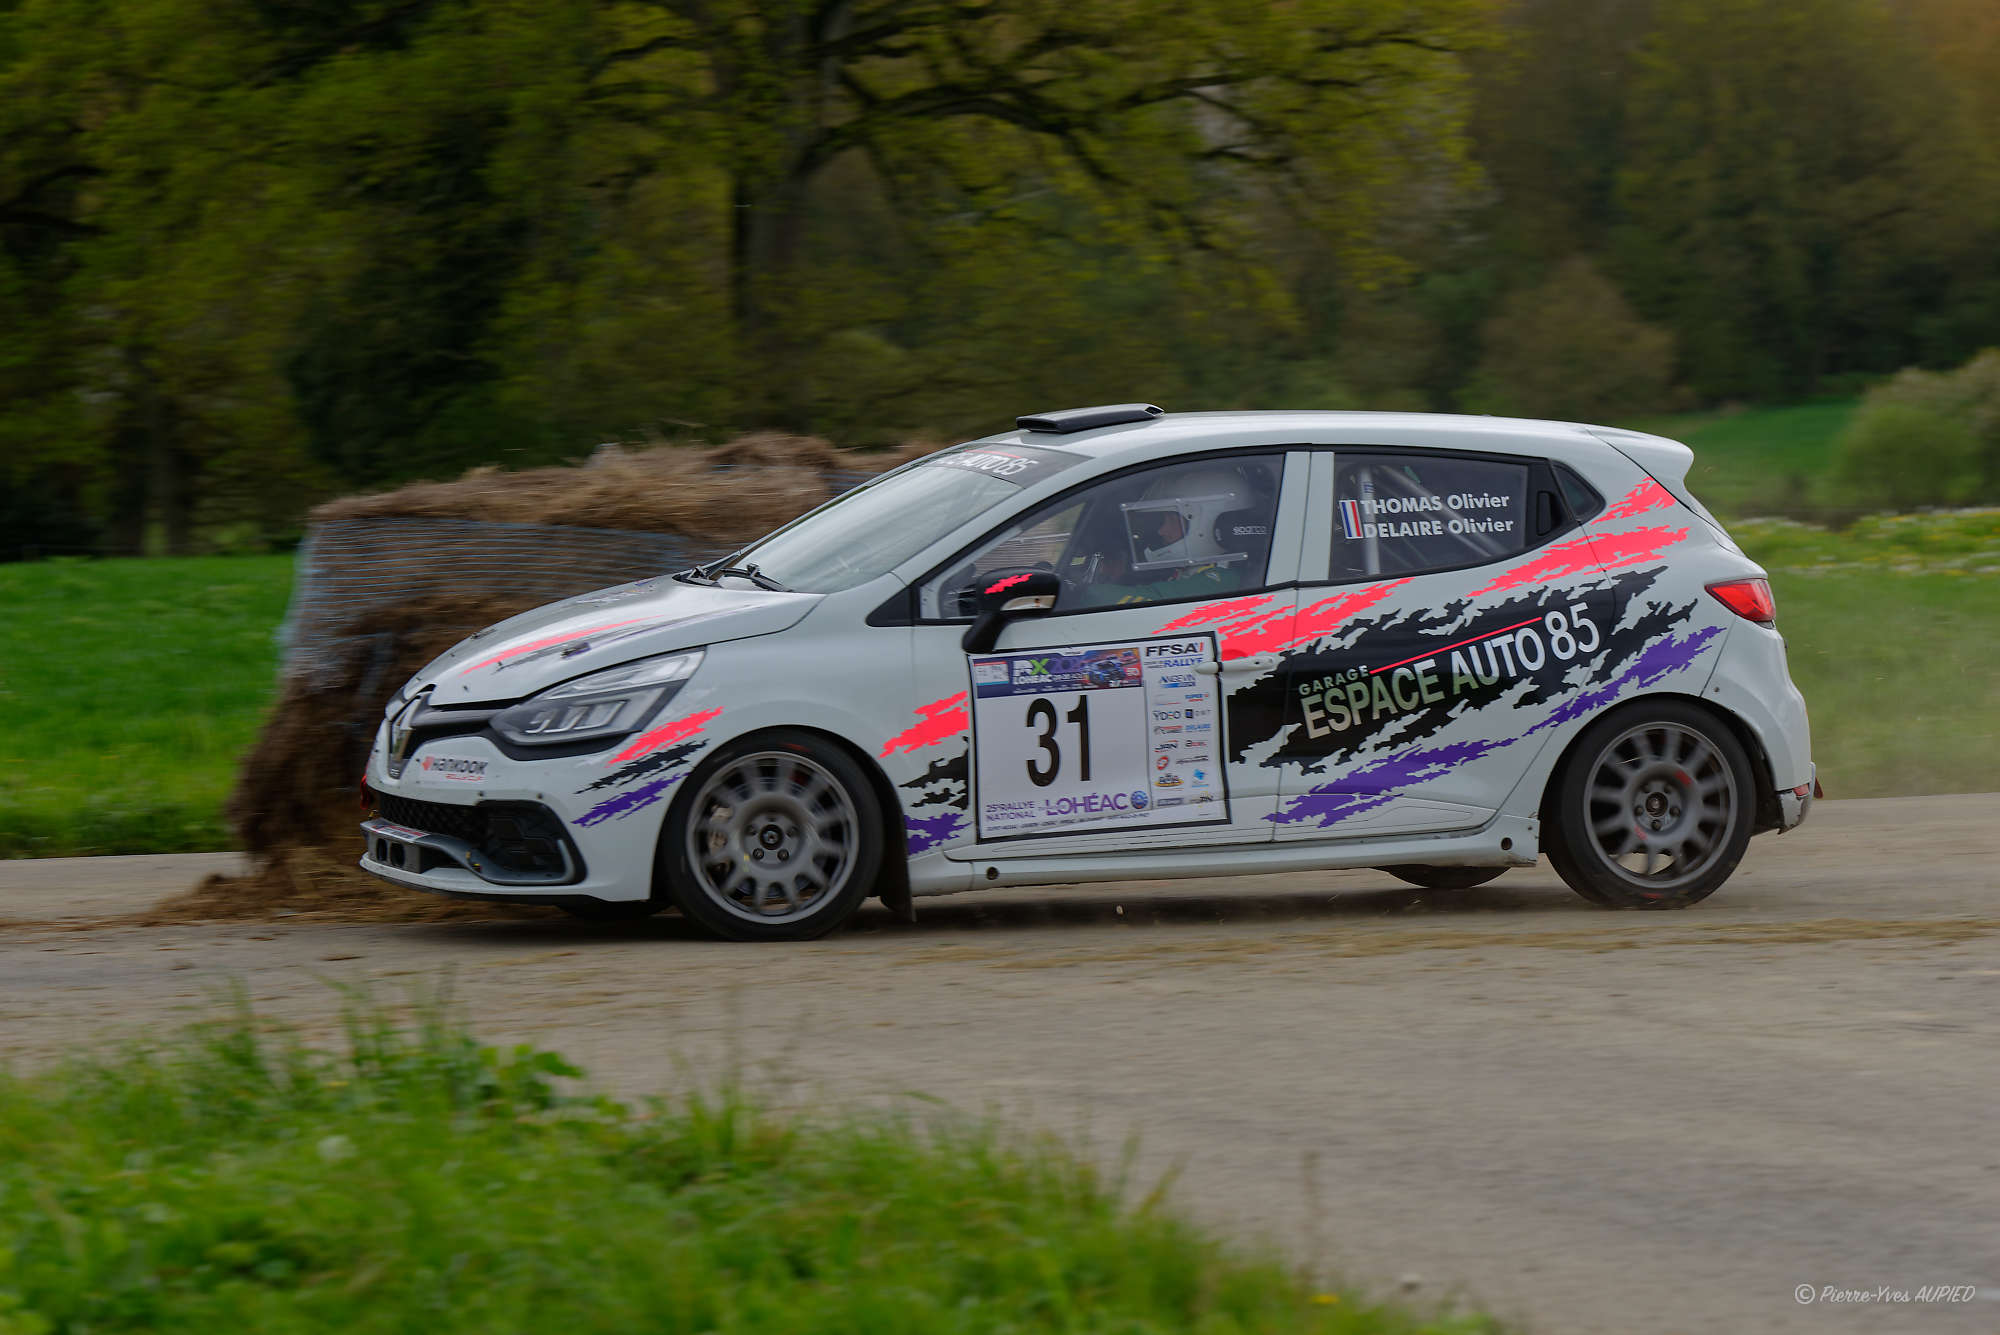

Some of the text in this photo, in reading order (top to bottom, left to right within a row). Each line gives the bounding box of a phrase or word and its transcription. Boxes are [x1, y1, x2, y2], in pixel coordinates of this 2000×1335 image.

[993, 457, 1040, 475] 85
[1360, 492, 1510, 514] THOMAS Olivier
[1363, 517, 1514, 538] DELAIRE Olivier
[1145, 643, 1198, 657] FFSA
[1299, 665, 1368, 695] GARAGE
[1301, 602, 1600, 739] ESPACE AUTO 85
[1026, 694, 1091, 787] 31
[1045, 792, 1129, 816] LOHÉAC
[986, 811, 1036, 822] NATIONAL
